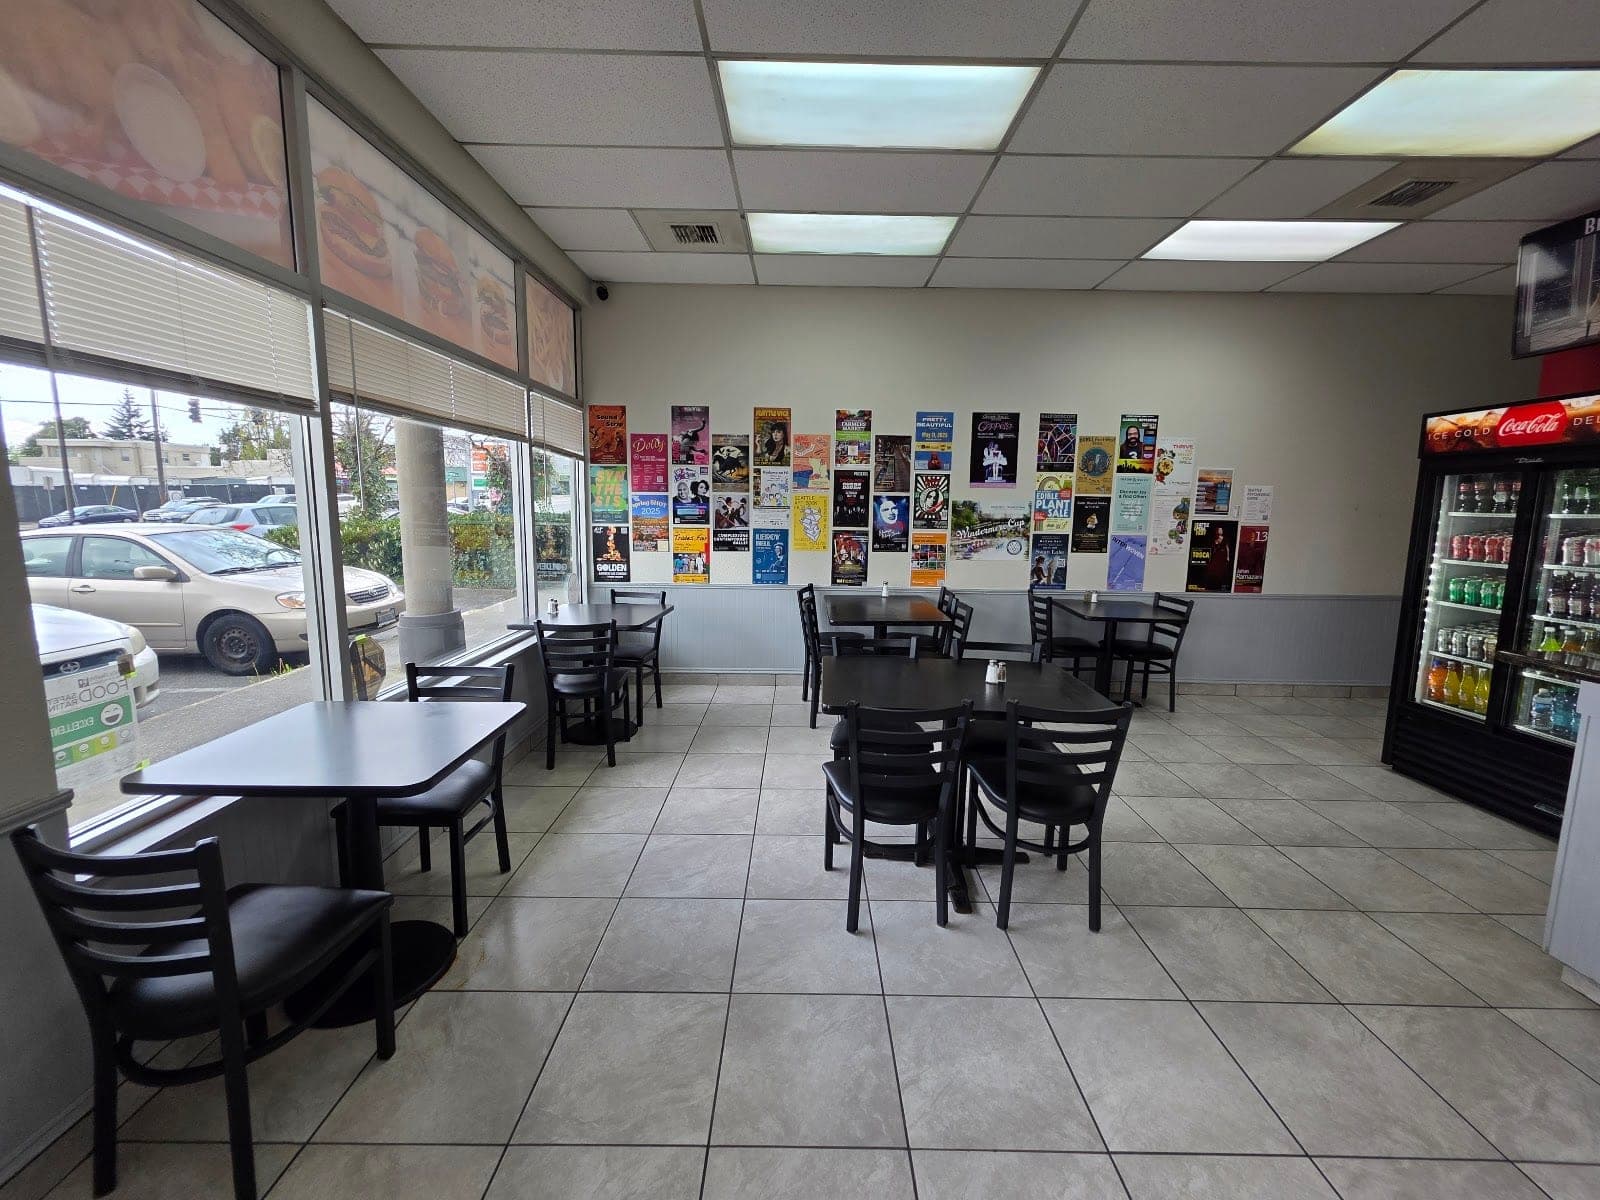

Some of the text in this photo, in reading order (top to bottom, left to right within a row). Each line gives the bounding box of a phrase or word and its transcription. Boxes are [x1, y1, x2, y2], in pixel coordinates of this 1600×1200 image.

[1499, 412, 1564, 437] Coca-Cola
[1428, 427, 1491, 441] ICE COLD
[633, 438, 665, 453] Dolly
[1035, 499, 1070, 509] PLANT
[641, 507, 661, 515] 2025
[1047, 509, 1069, 518] SALE
[1007, 518, 1025, 528] Cup
[1254, 531, 1268, 542] 13
[596, 563, 628, 571] GOLDEN
